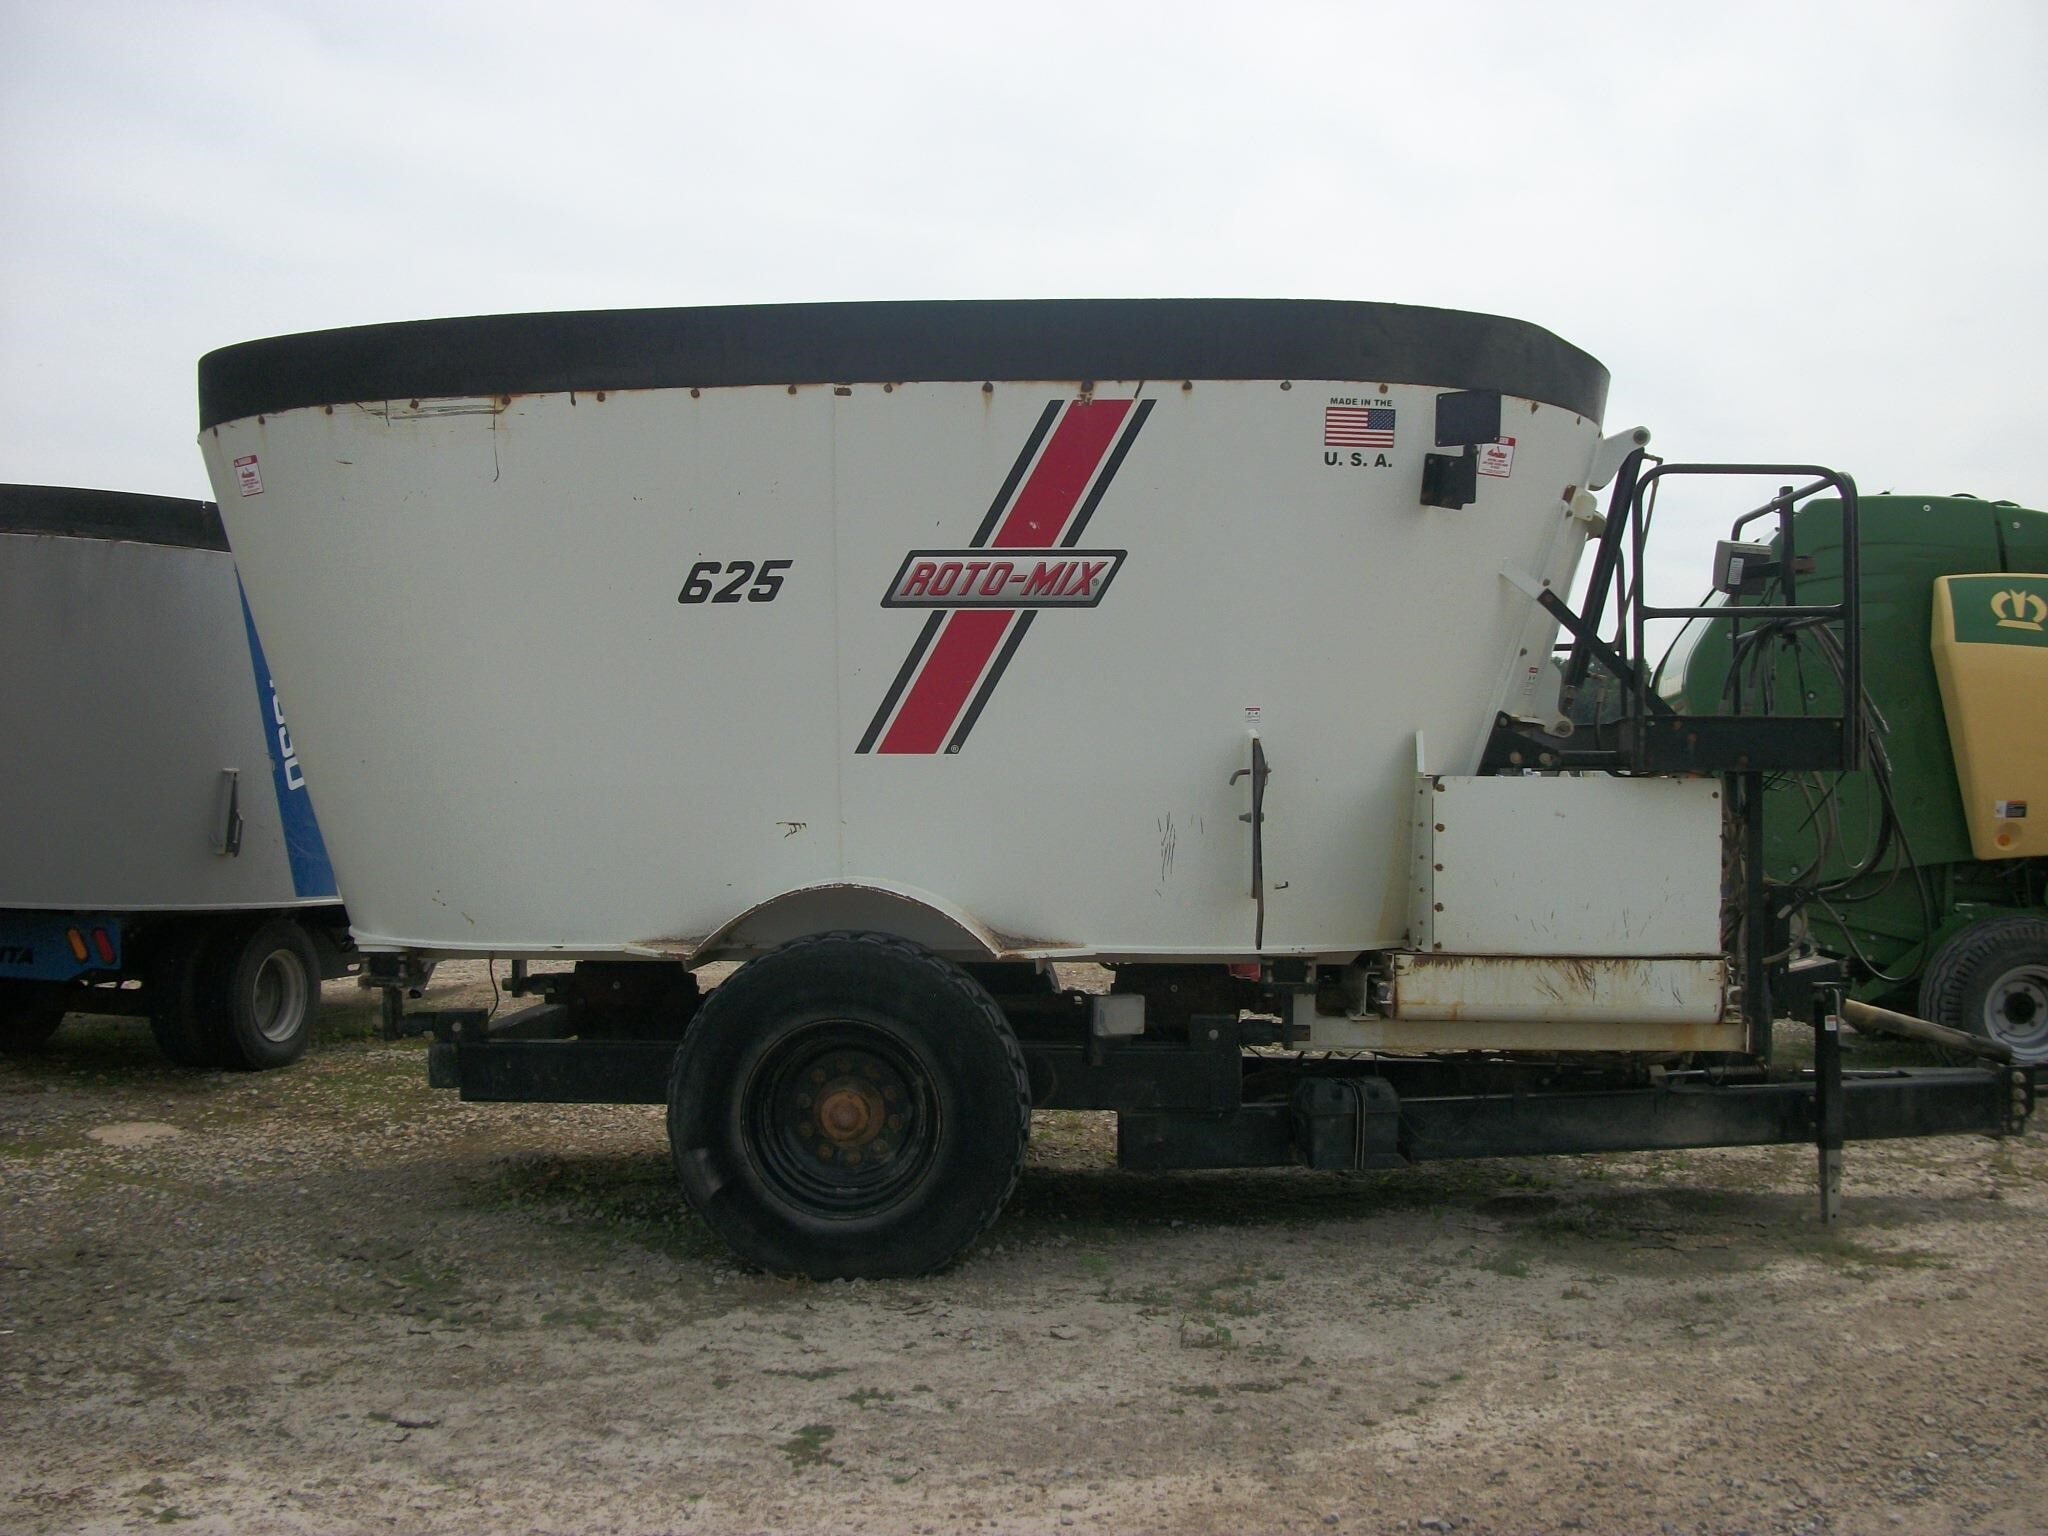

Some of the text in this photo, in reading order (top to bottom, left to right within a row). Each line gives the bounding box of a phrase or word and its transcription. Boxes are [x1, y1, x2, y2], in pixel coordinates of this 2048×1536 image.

[1330, 397, 1358, 406] MADE
[1374, 399, 1393, 407] THE
[677, 559, 794, 604] 625
